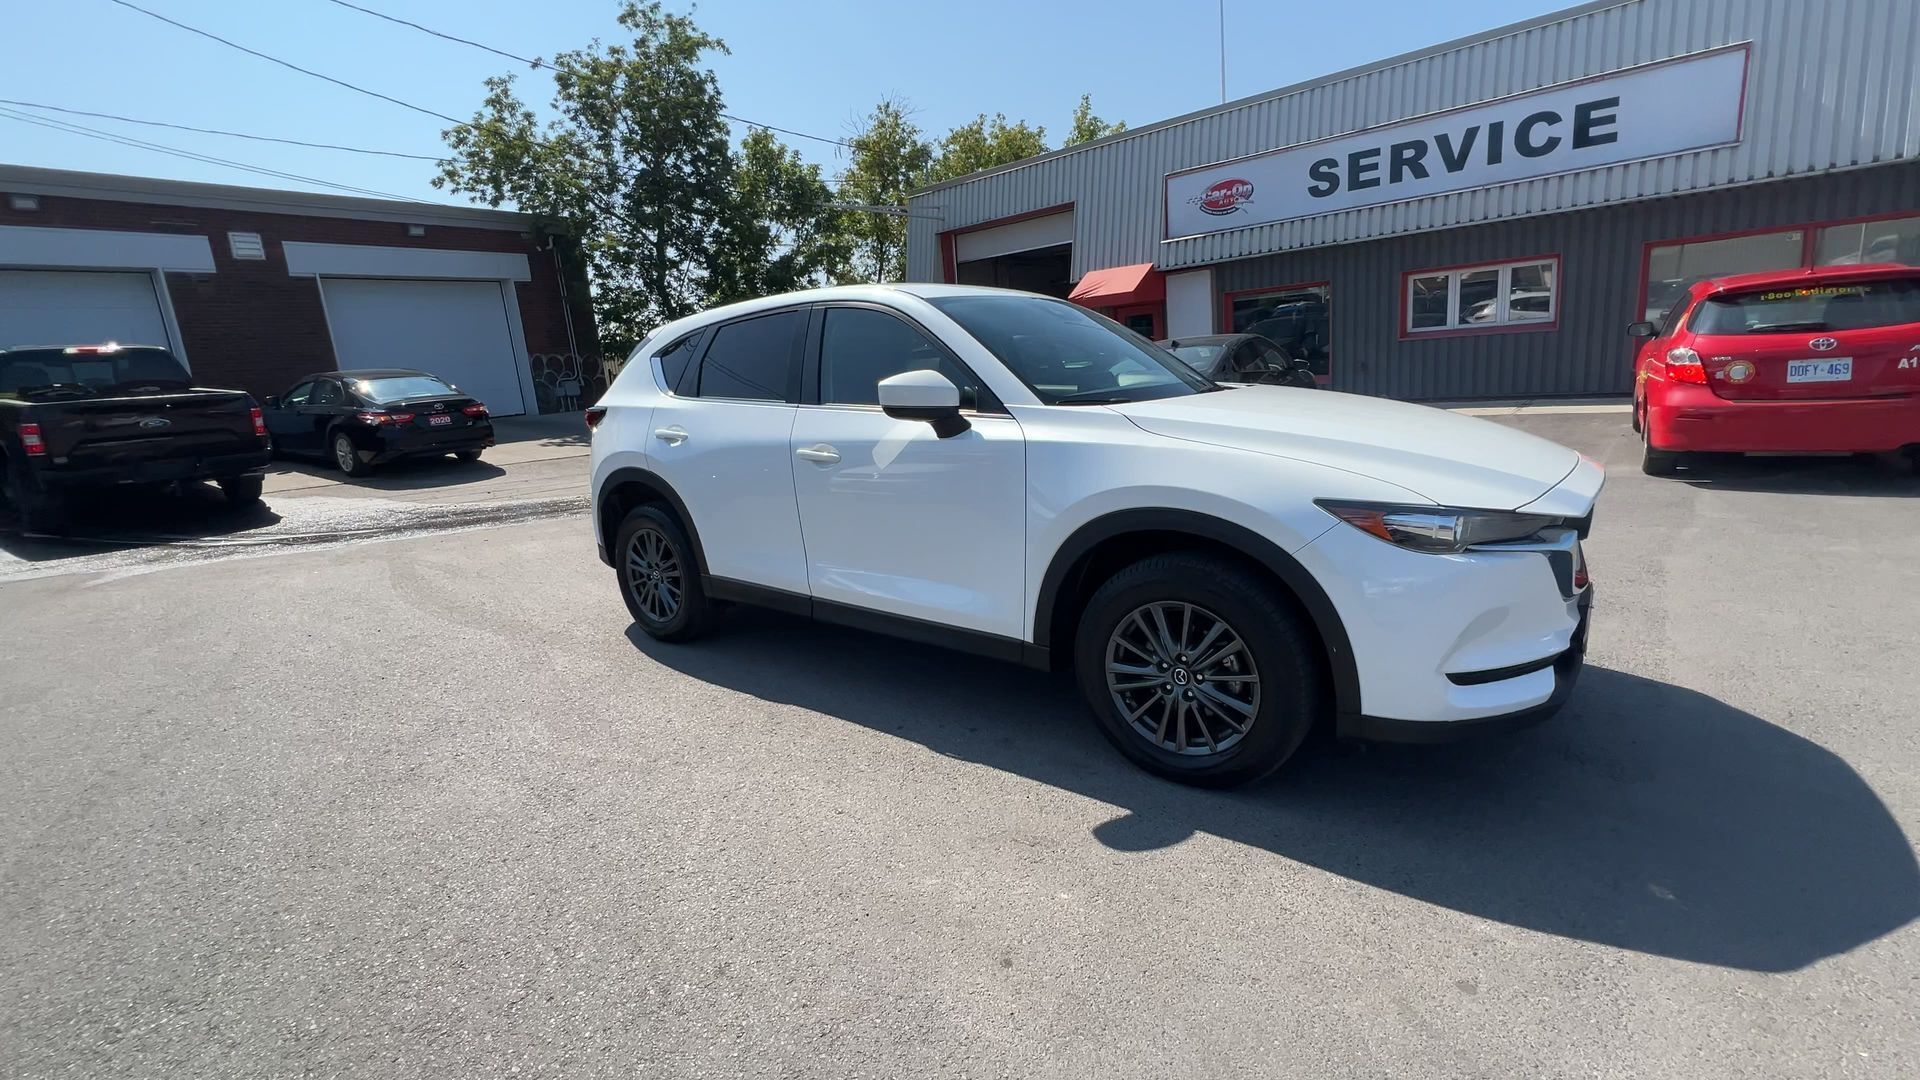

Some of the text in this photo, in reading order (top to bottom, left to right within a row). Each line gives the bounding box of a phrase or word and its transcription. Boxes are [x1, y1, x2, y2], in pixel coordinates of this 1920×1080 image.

[1307, 96, 1621, 198] SERVICE
[1827, 363, 1850, 375] 469
[430, 416, 451, 424] 2020
